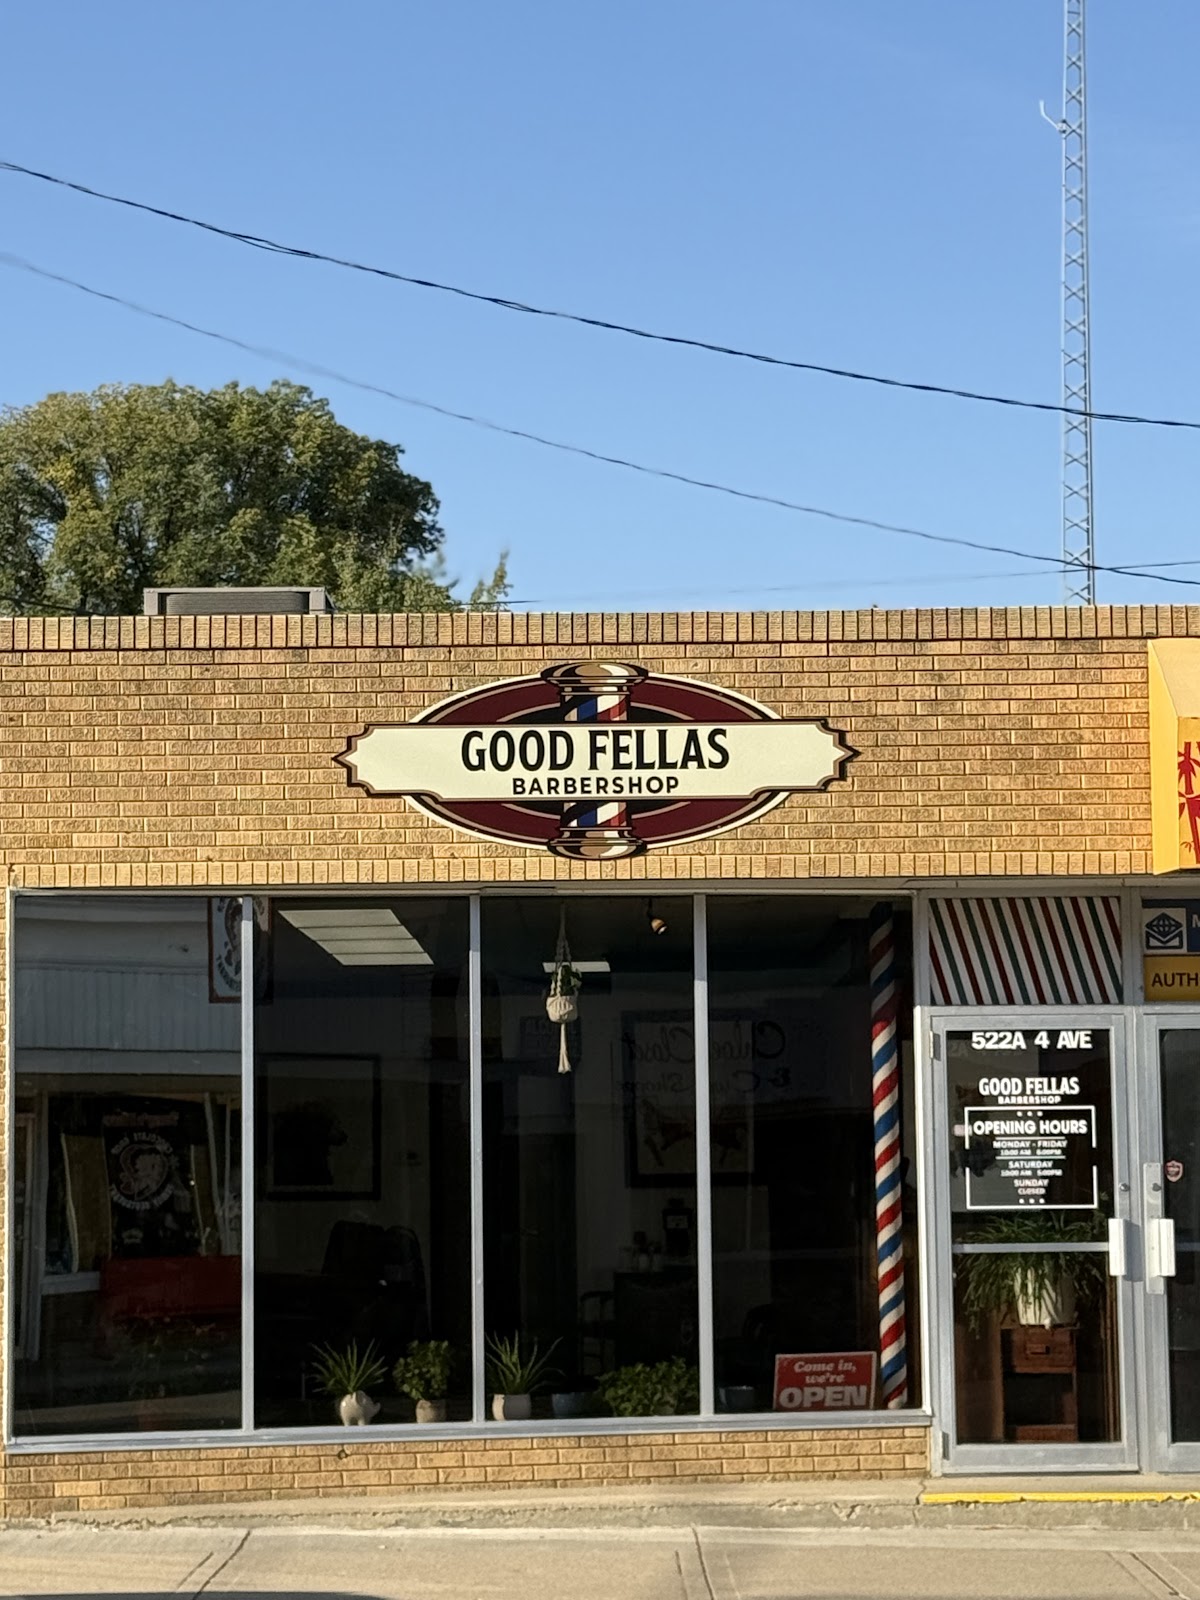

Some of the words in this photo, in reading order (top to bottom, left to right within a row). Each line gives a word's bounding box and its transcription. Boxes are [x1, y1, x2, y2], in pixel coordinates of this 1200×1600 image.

[461, 730, 574, 772] GOOD
[588, 728, 730, 771] FELLAS
[512, 776, 680, 796] BARBERSHOP
[1152, 972, 1199, 988] AUTH
[971, 1031, 1026, 1050] 522A
[1034, 1031, 1050, 1049] 4
[1056, 1030, 1093, 1049] AVE
[979, 1077, 1022, 1096] GOOD
[1025, 1076, 1080, 1095] FELLAS
[997, 1096, 1061, 1105] BARBERSHOP
[973, 1120, 1036, 1135] OPENING
[1039, 1119, 1088, 1134] HOURS
[992, 1141, 1031, 1149] MONDAY
[1037, 1140, 1068, 1148] FRIDAY
[1008, 1160, 1054, 1169] SATURDAY
[1013, 1178, 1049, 1187] SUNDAY
[1017, 1187, 1046, 1196] CLOSED
[794, 1361, 835, 1373] Come
[837, 1360, 857, 1372] in,
[805, 1372, 845, 1384] we're
[779, 1385, 867, 1408] OPEN
